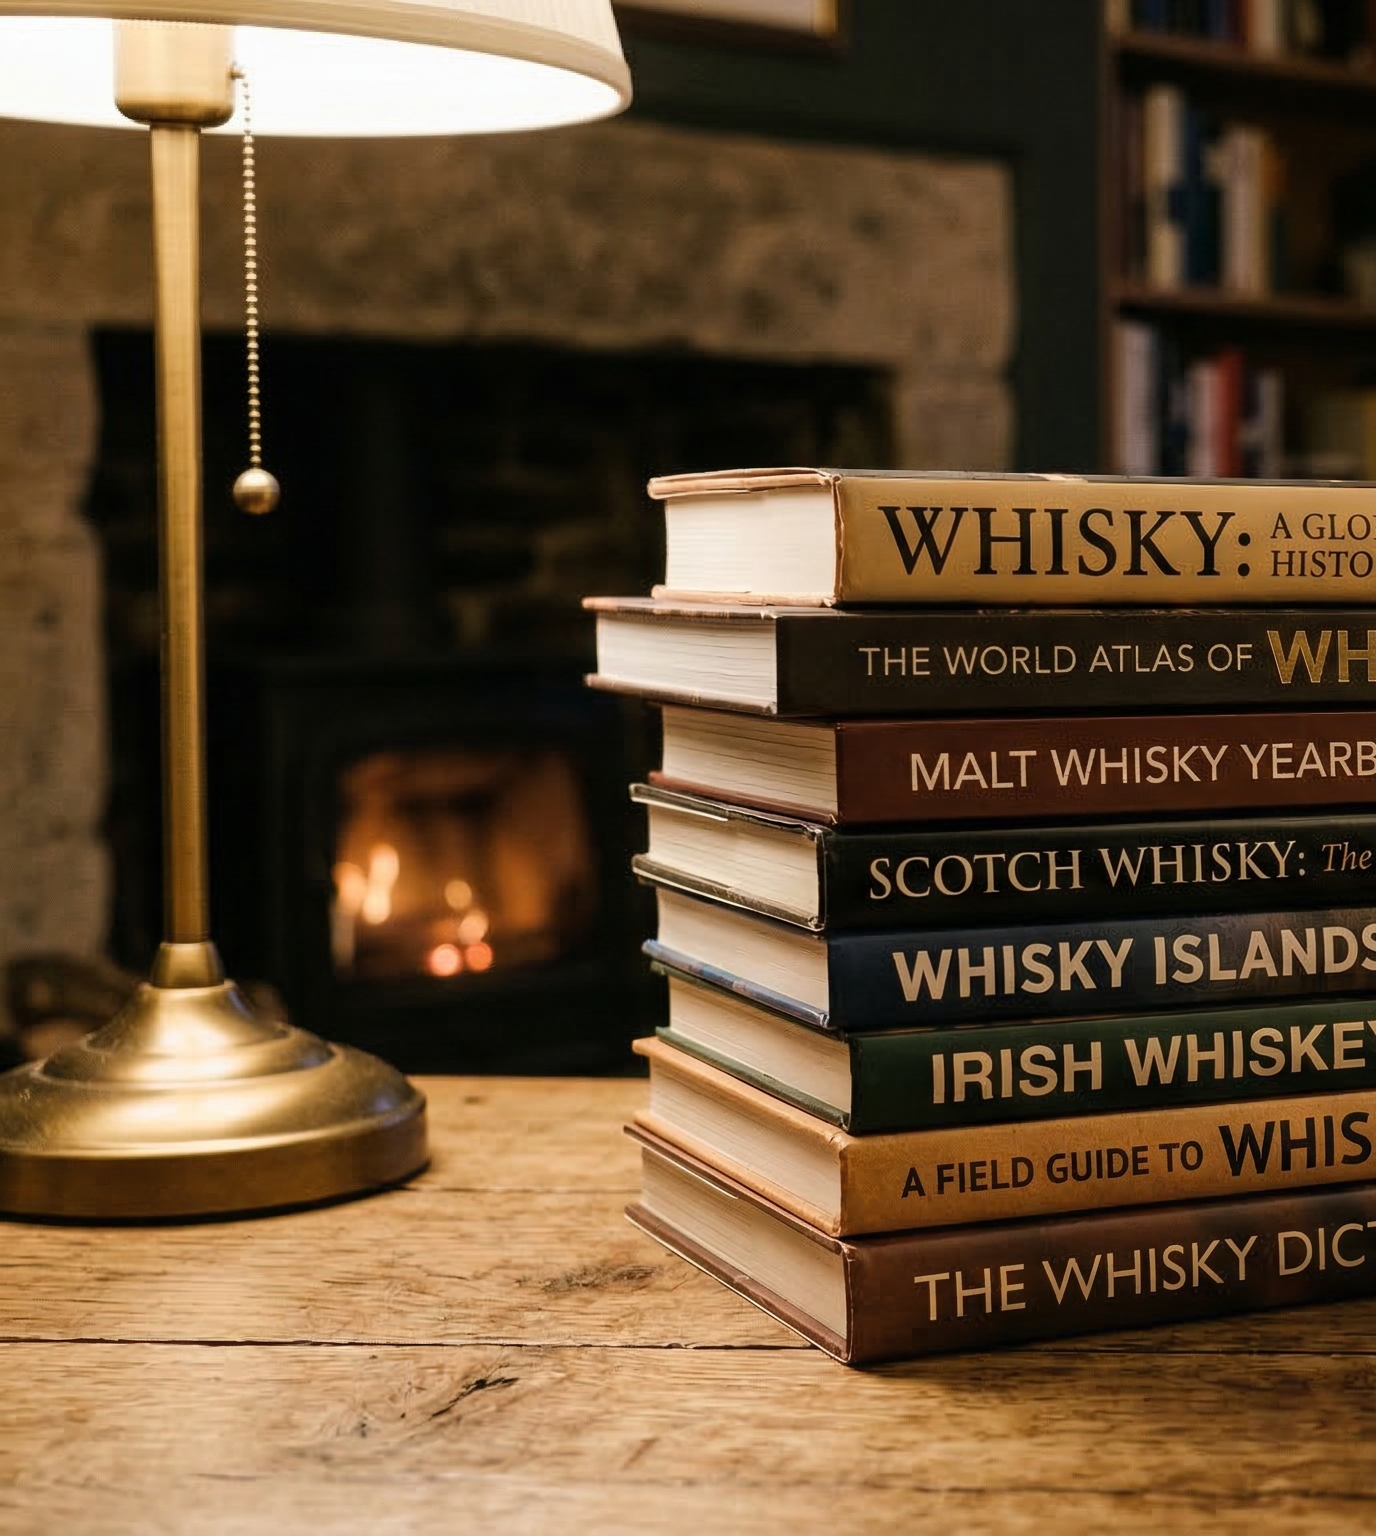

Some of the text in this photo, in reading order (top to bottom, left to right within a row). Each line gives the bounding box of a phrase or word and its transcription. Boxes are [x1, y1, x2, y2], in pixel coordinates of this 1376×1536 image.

[877, 506, 1251, 577] WHISKY:
[1270, 512, 1292, 540] A
[858, 647, 930, 676] THE
[943, 645, 1077, 675] WORLD
[1089, 644, 1194, 673] ATLAS
[1207, 643, 1253, 671] OF
[911, 750, 1037, 791] MALT
[1050, 745, 1228, 786] WHISKY
[869, 849, 1085, 900] SCOTCH
[1098, 840, 1306, 888] WHISKY:
[1322, 842, 1372, 873] The
[893, 938, 1134, 1002] WHISKY
[932, 1042, 1102, 1104] IRISH
[901, 1167, 926, 1199] A
[937, 1157, 1034, 1195] FIELD
[1046, 1146, 1149, 1184] GUIDE
[1158, 1141, 1203, 1172] TO
[914, 1264, 1026, 1321] THE
[1042, 1235, 1258, 1305] WHISKY
